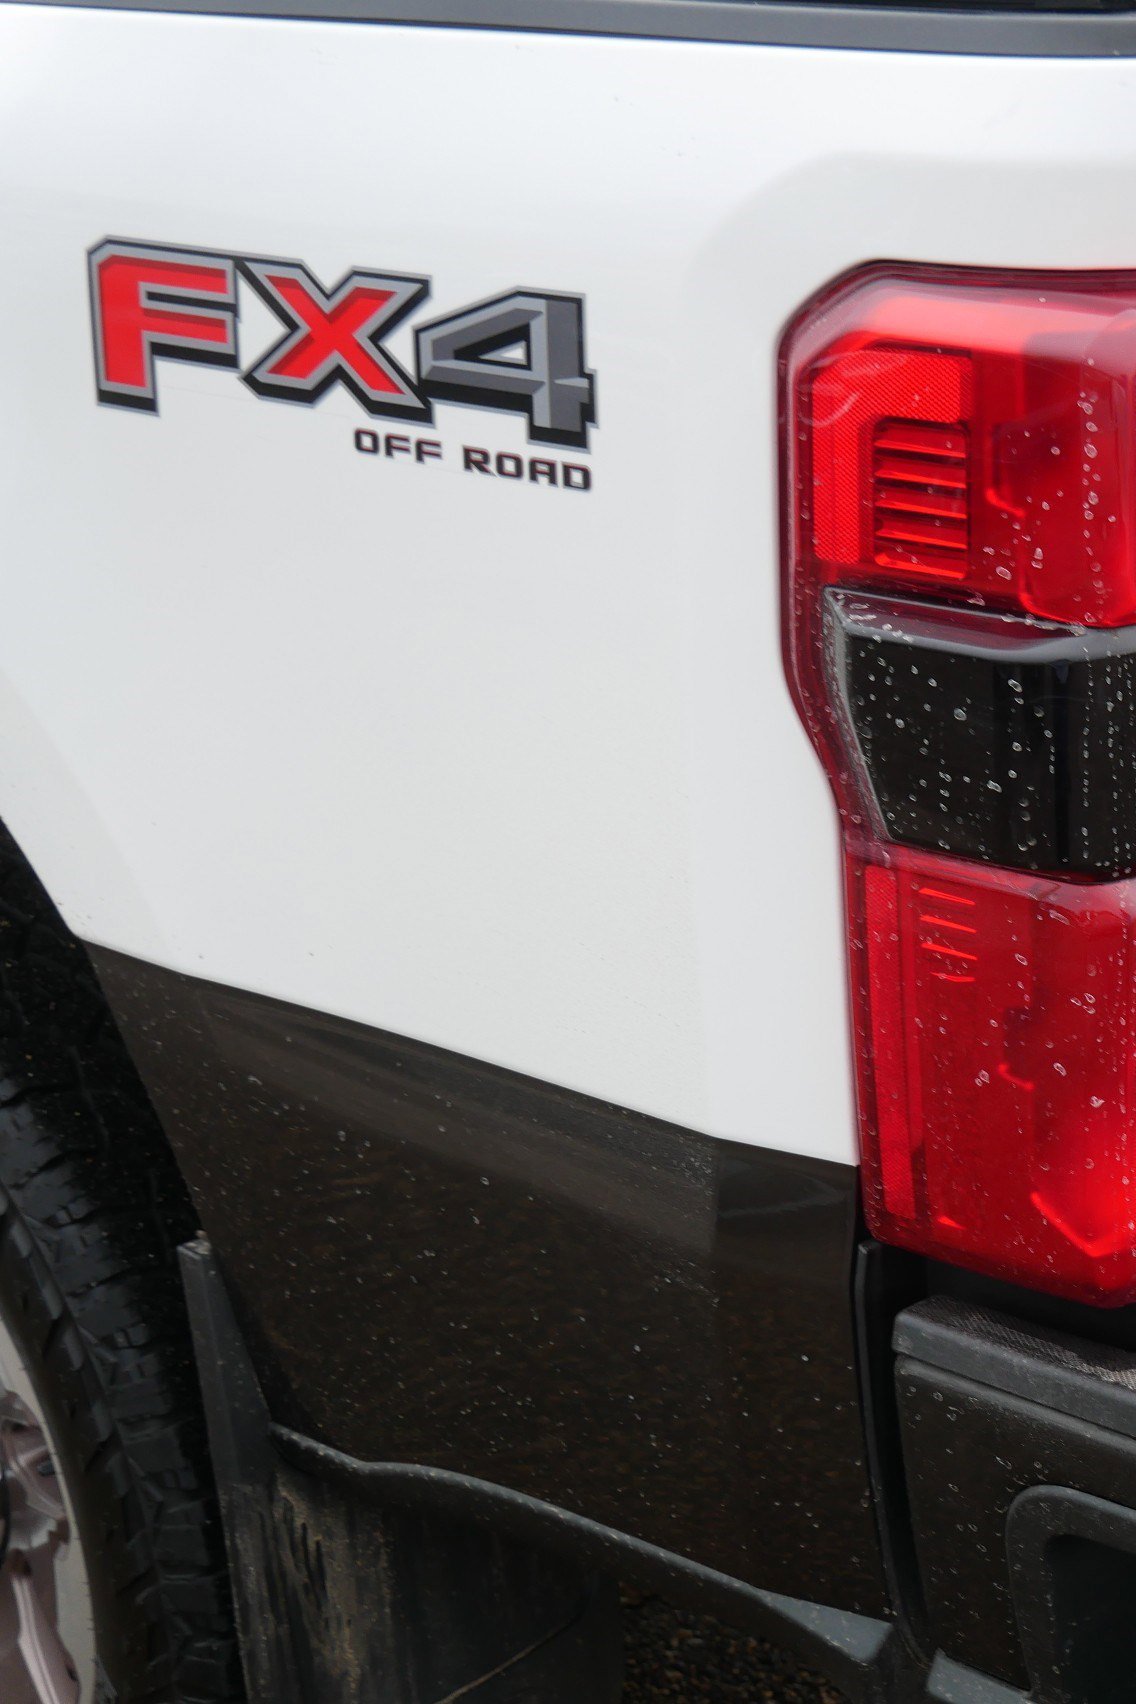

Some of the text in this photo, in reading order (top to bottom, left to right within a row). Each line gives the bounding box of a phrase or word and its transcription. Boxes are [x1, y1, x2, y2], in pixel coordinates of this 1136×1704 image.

[87, 234, 598, 453] FX4
[353, 427, 592, 492] OFF ROAD
